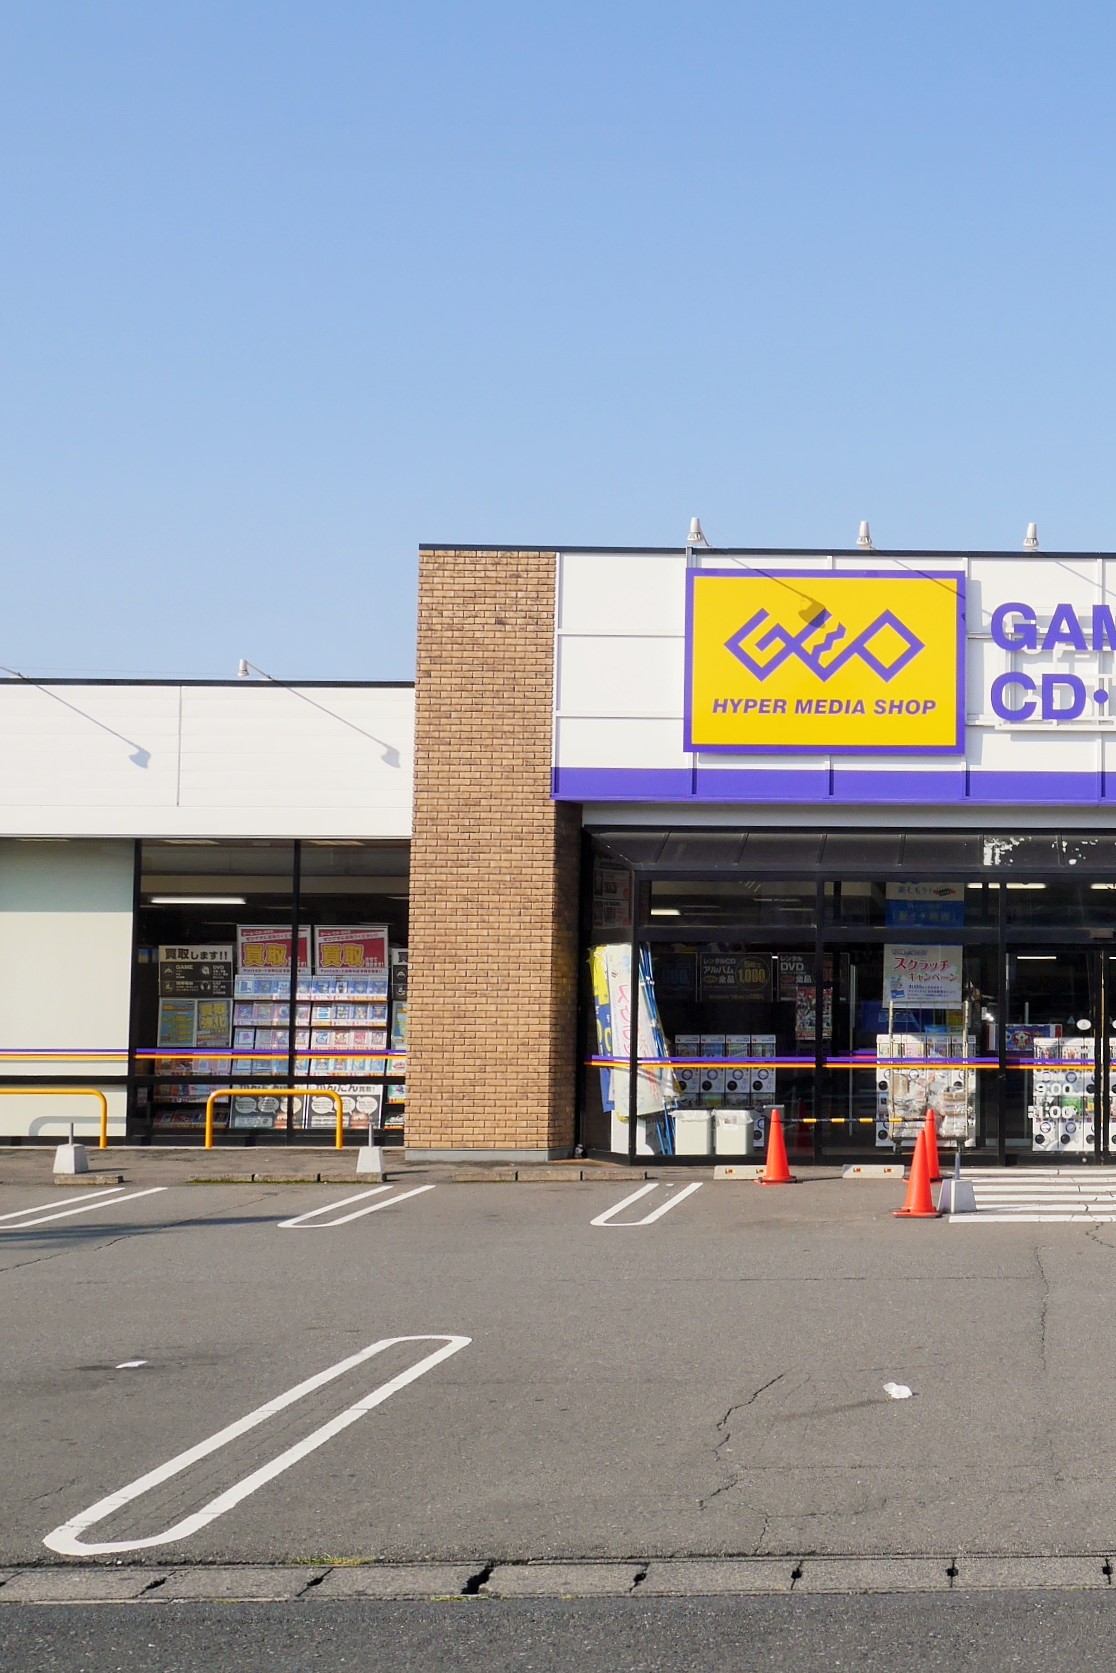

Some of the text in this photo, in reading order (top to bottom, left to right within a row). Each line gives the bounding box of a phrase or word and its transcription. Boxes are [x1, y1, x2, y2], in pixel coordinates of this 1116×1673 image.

[712, 699, 937, 715] HYPER MEDIA SHOP
[780, 962, 804, 971] DVD
